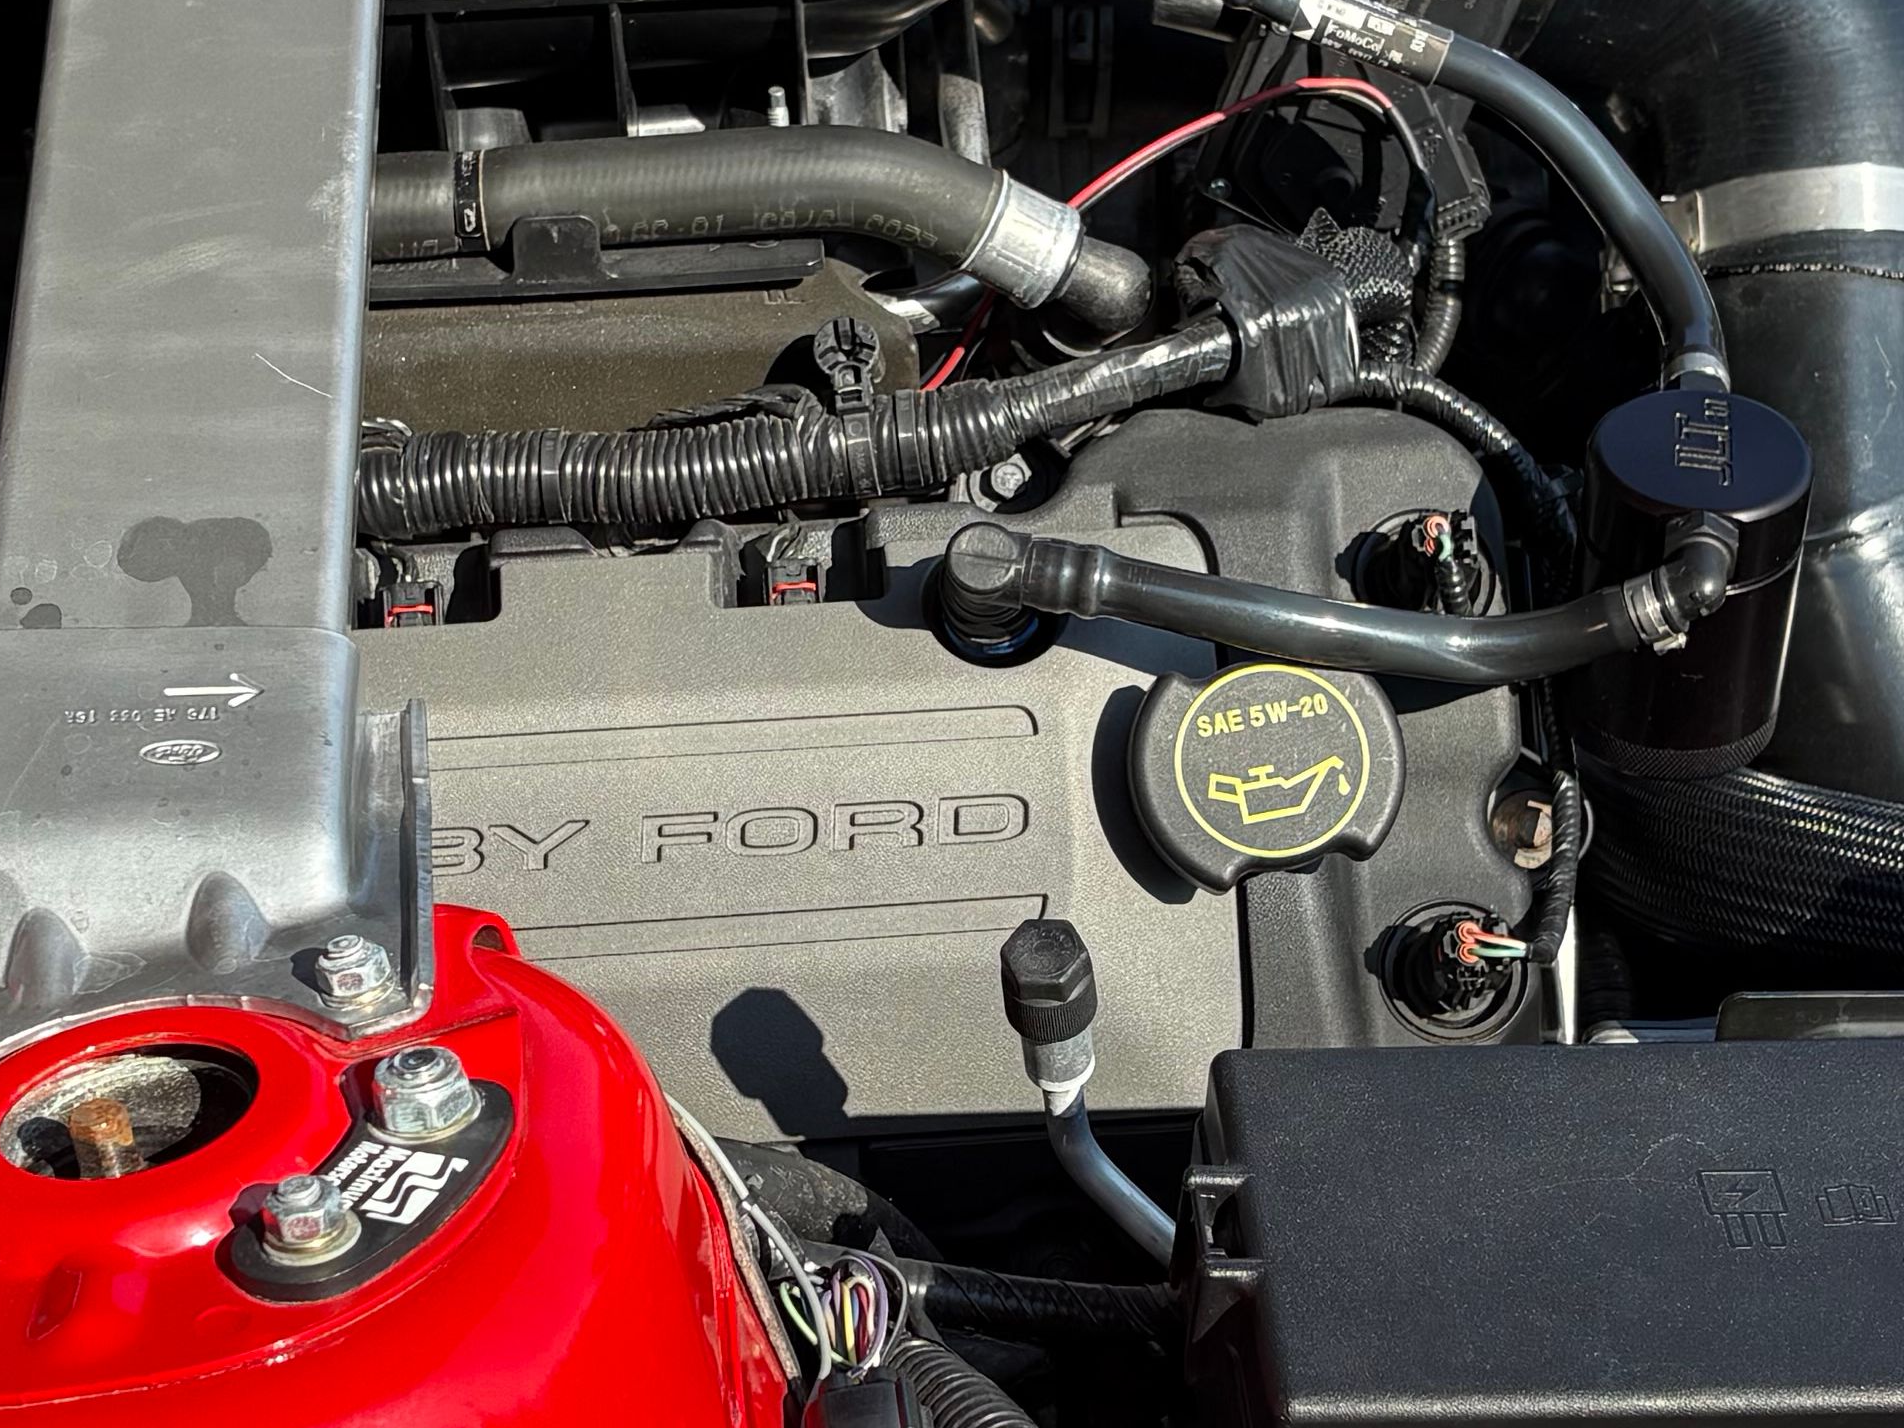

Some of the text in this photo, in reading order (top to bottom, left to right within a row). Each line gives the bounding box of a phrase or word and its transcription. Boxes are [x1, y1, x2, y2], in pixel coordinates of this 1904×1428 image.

[1197, 693, 1329, 738] SAE 5W-20
[432, 793, 1030, 876] BY FORD
